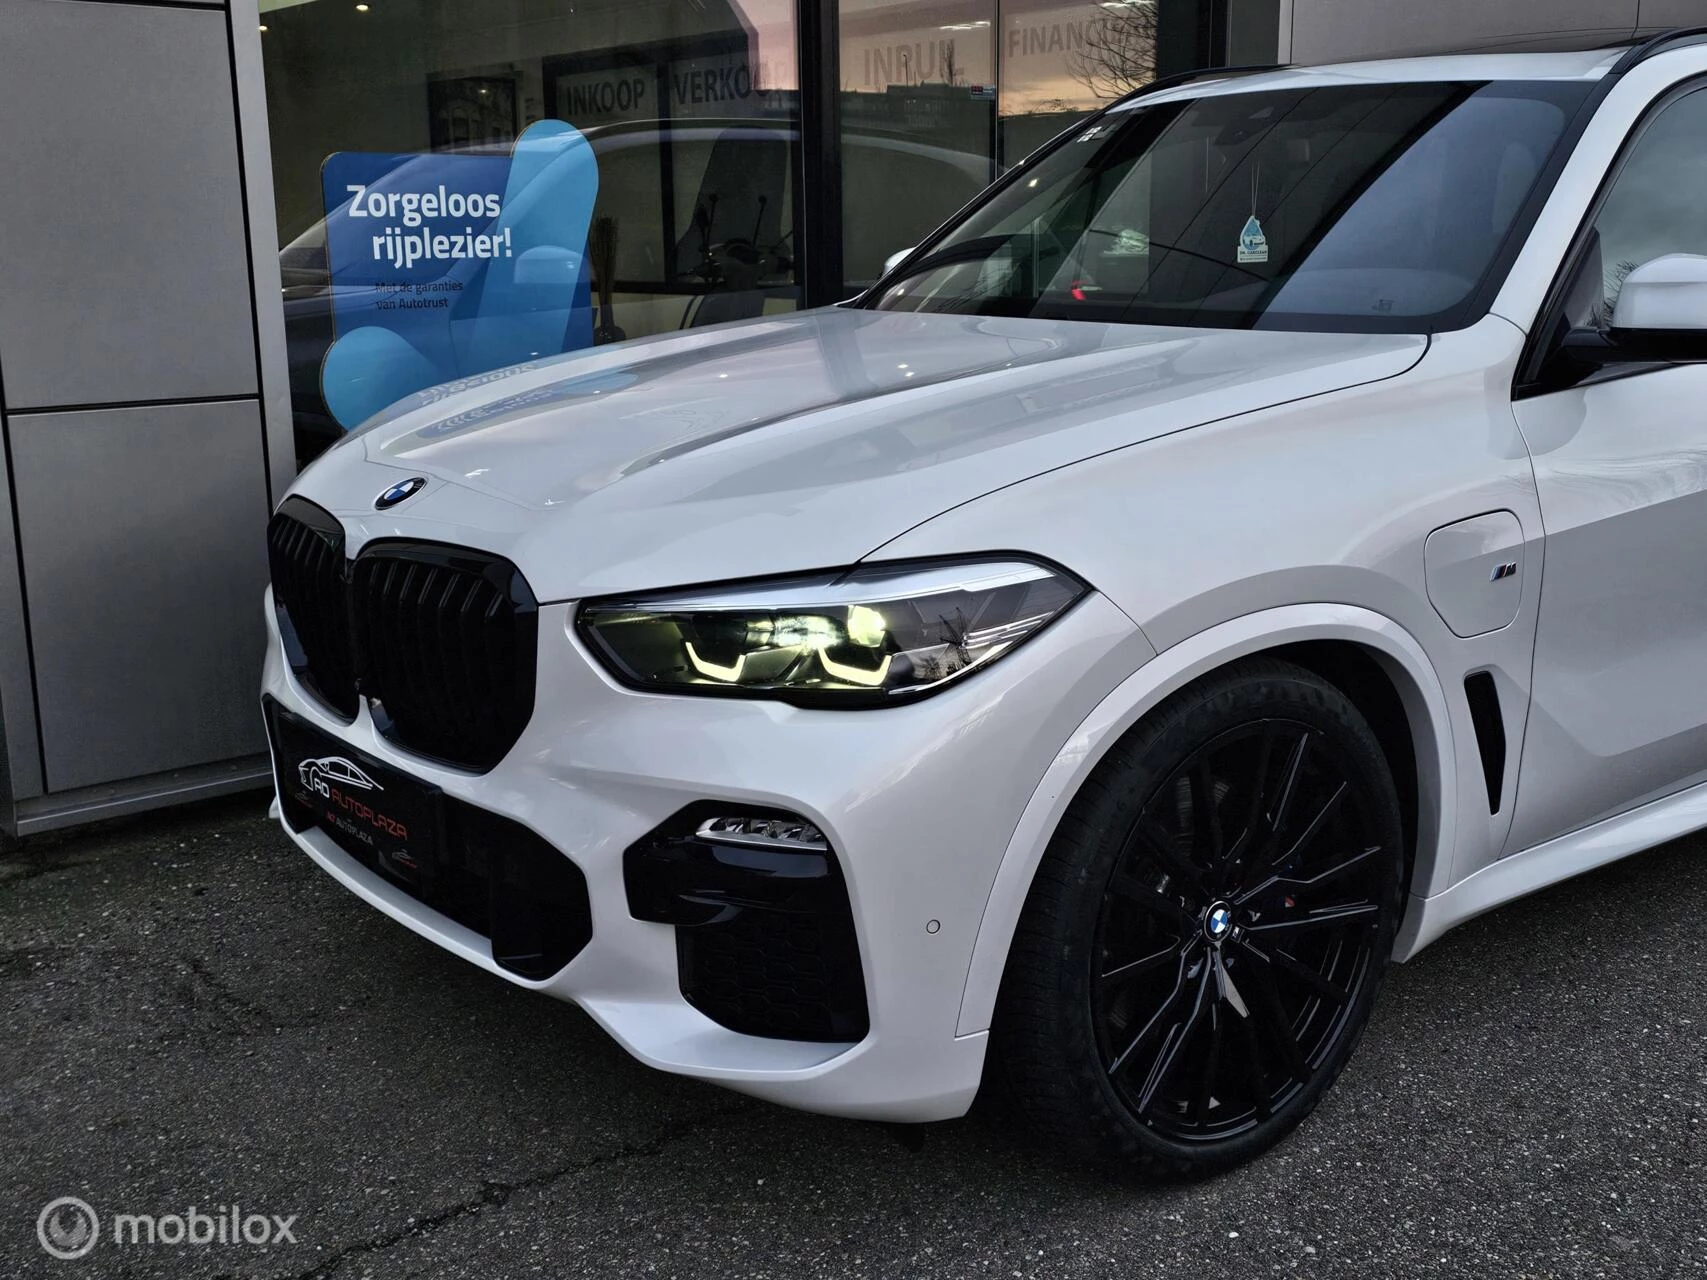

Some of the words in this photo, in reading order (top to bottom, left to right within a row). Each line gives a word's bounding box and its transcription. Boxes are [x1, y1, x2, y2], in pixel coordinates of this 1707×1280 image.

[566, 77, 645, 116] INKOOP
[346, 184, 501, 227] Zorgeloos
[372, 226, 513, 270] rijplezier!
[375, 281, 397, 293] Met
[400, 281, 413, 293] de
[415, 281, 464, 295] garanties
[376, 300, 396, 310] van
[399, 298, 449, 310] Autotrust
[331, 787, 408, 841] AUTOPLAZA
